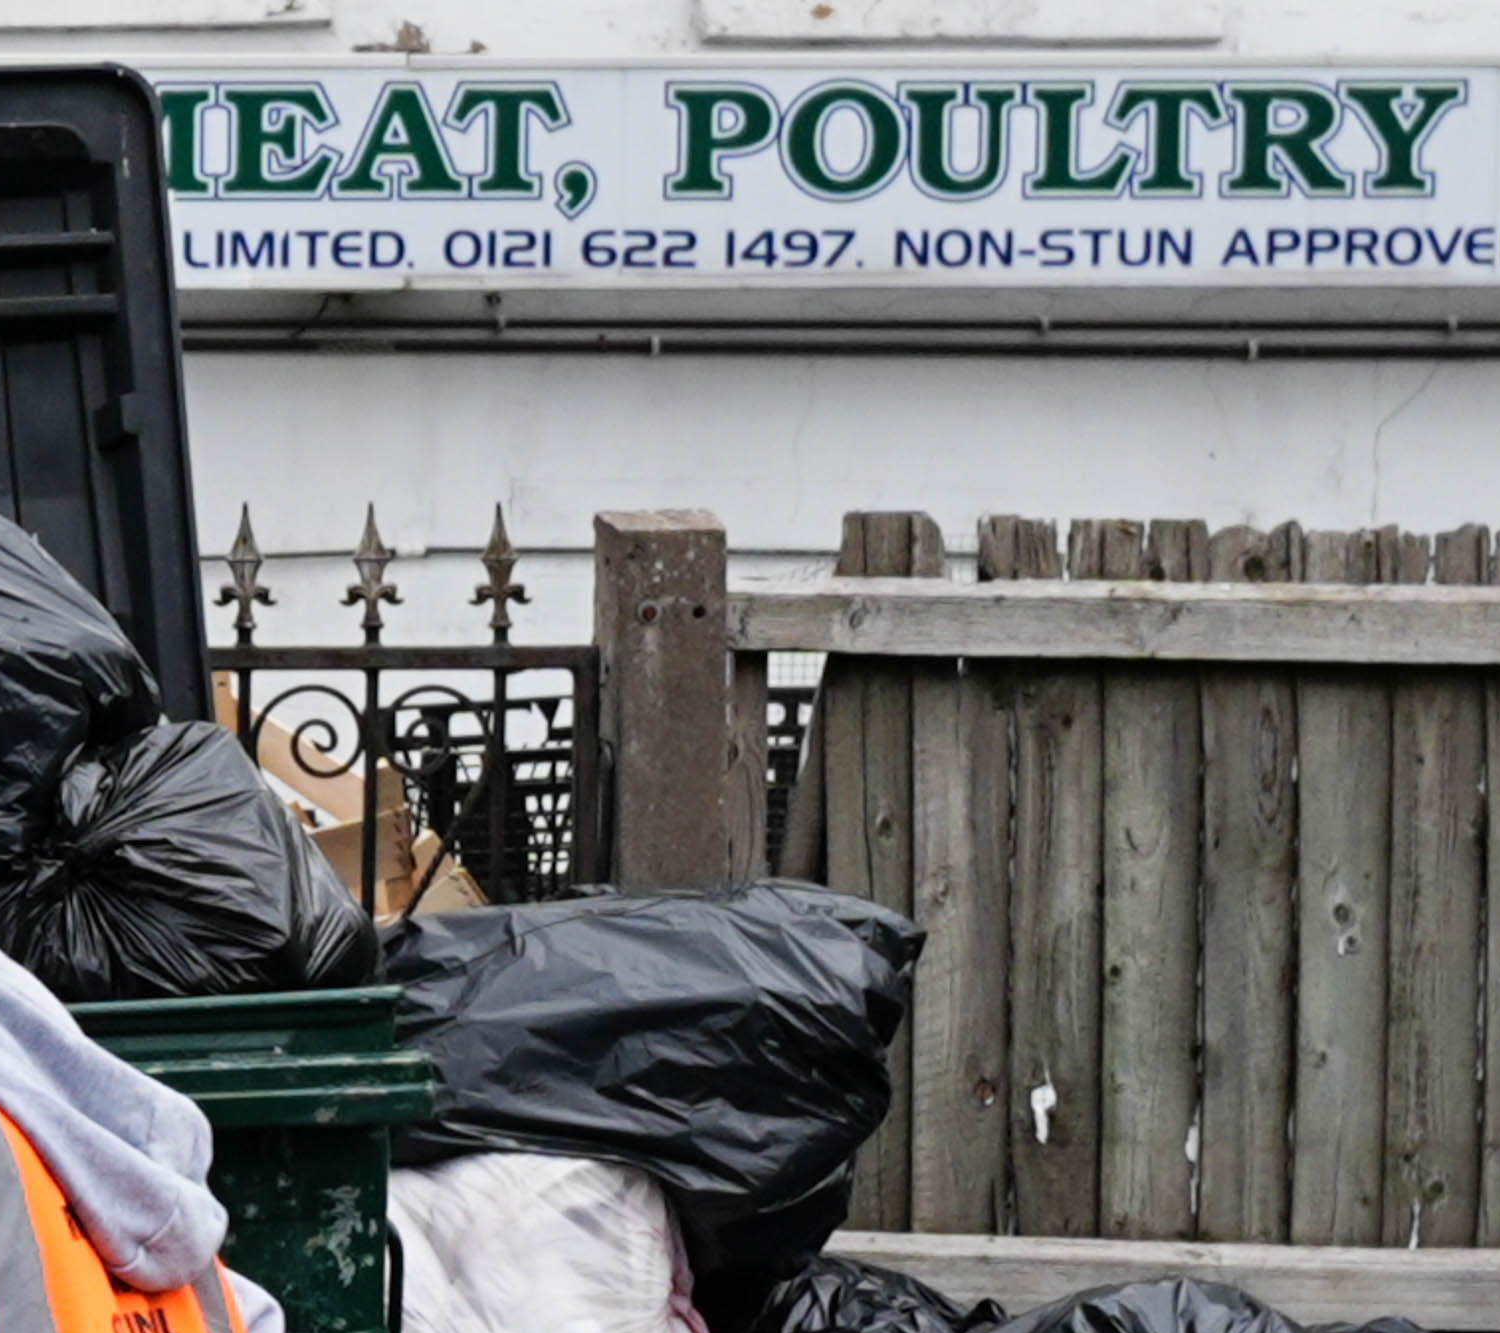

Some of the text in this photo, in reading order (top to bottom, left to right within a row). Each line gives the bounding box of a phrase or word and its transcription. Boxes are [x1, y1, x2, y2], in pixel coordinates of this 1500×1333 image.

[663, 78, 1469, 202] POULTRY
[183, 230, 414, 269] LIMITED.
[443, 230, 552, 268] 0121
[581, 230, 697, 268] 622
[725, 229, 864, 268] 1497.
[894, 229, 1193, 268] NON-STUN
